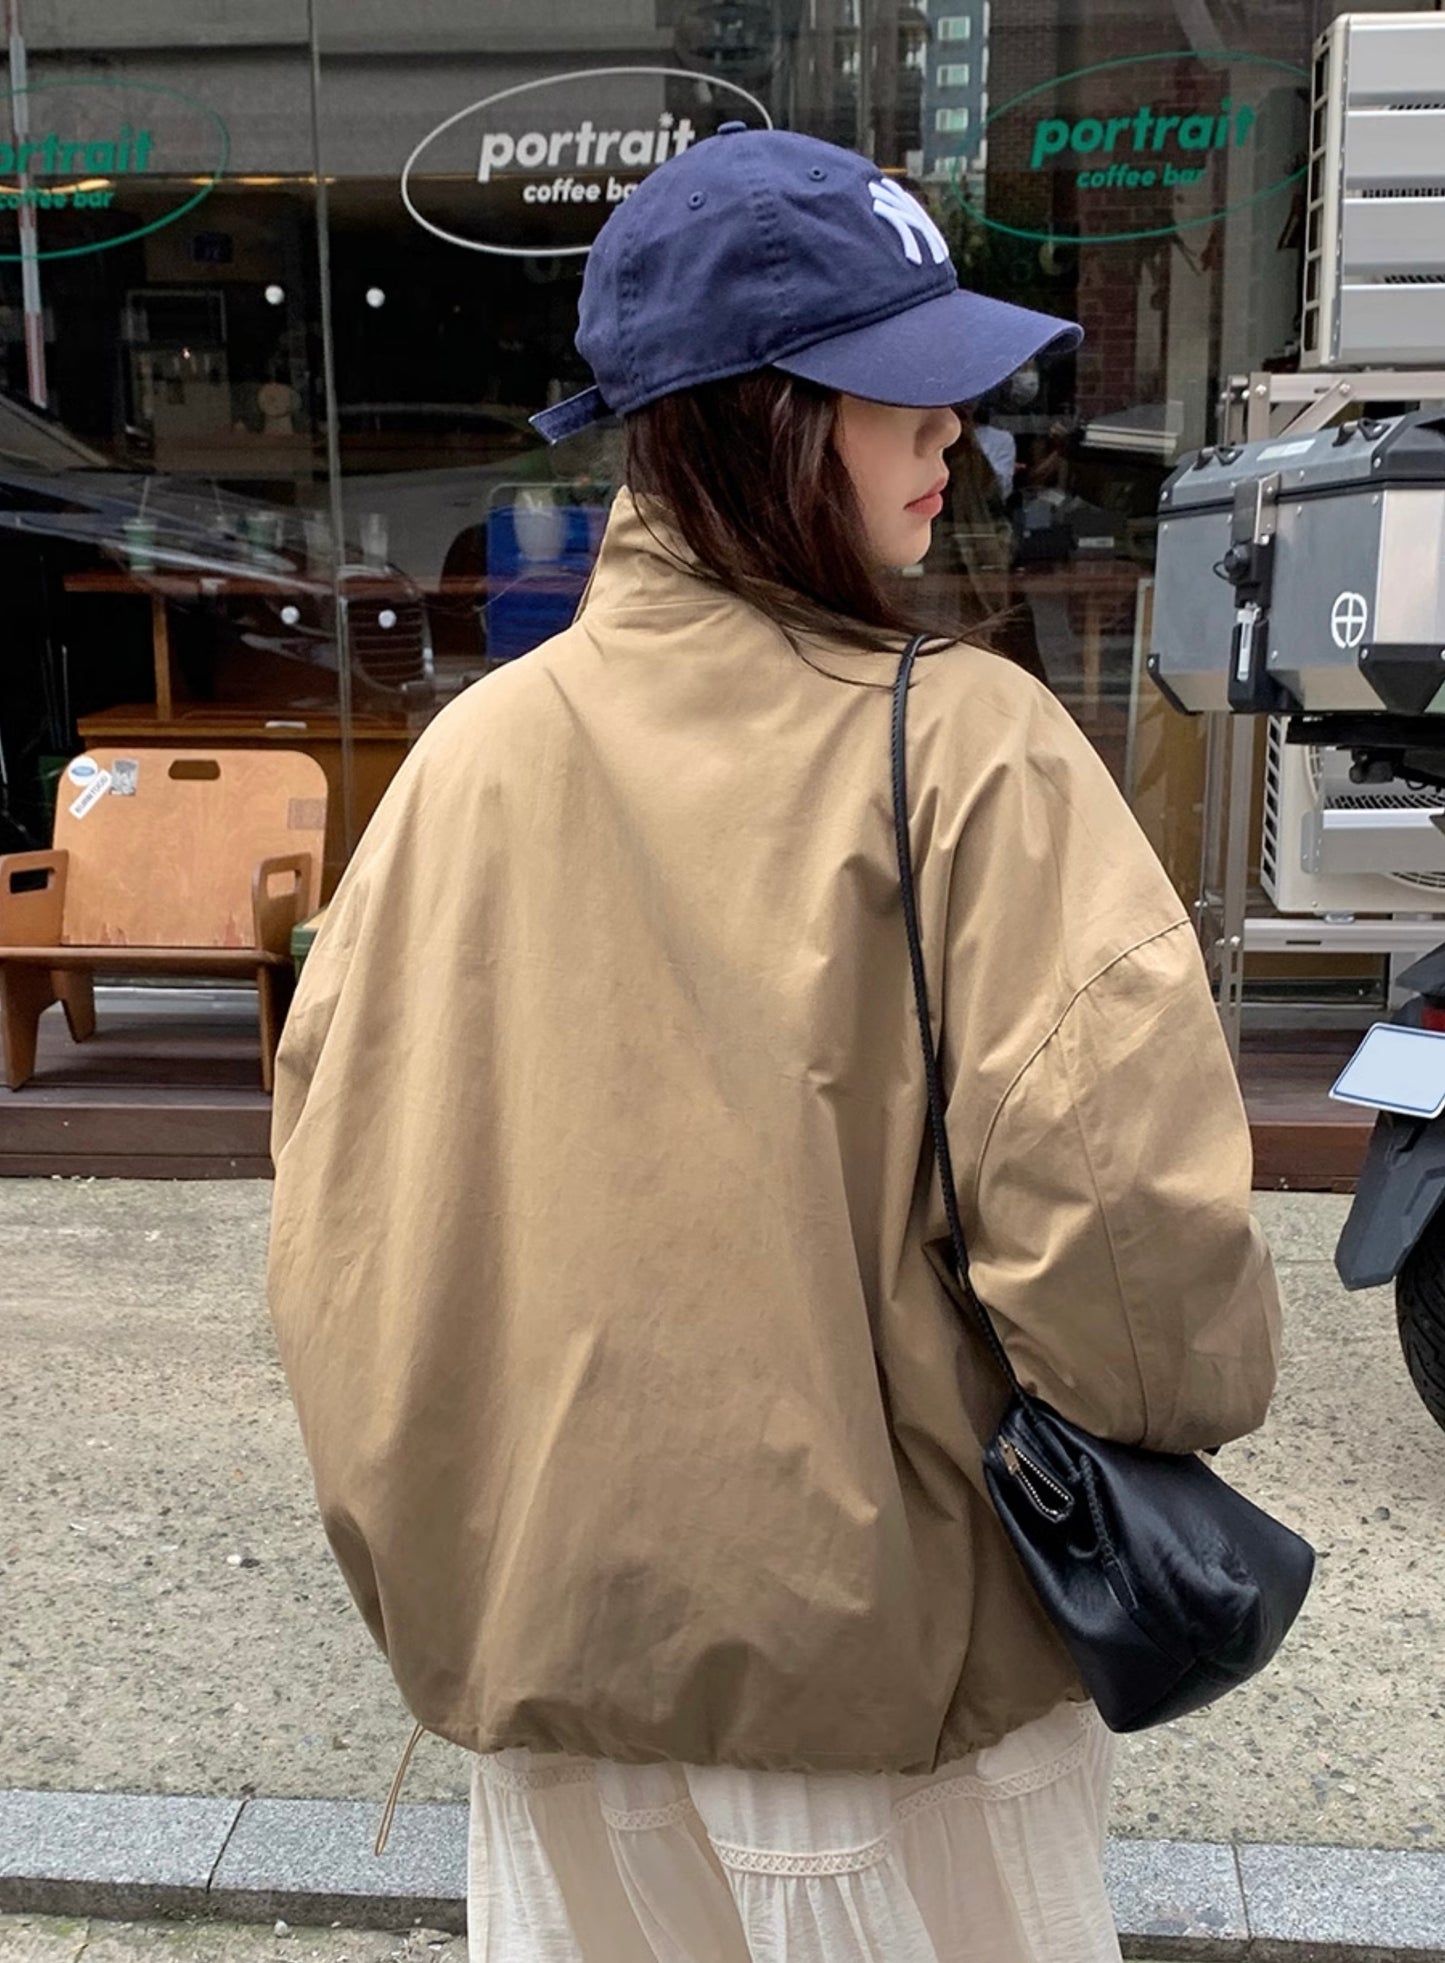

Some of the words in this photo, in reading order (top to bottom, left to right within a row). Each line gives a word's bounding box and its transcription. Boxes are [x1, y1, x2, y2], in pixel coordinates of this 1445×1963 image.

[477, 111, 697, 184] portrait
[1030, 96, 1256, 170] portrait
[523, 176, 601, 203] coffee
[605, 175, 639, 202] ba
[1075, 163, 1157, 190] coffee
[1161, 161, 1207, 187] bar
[72, 188, 115, 209] bar
